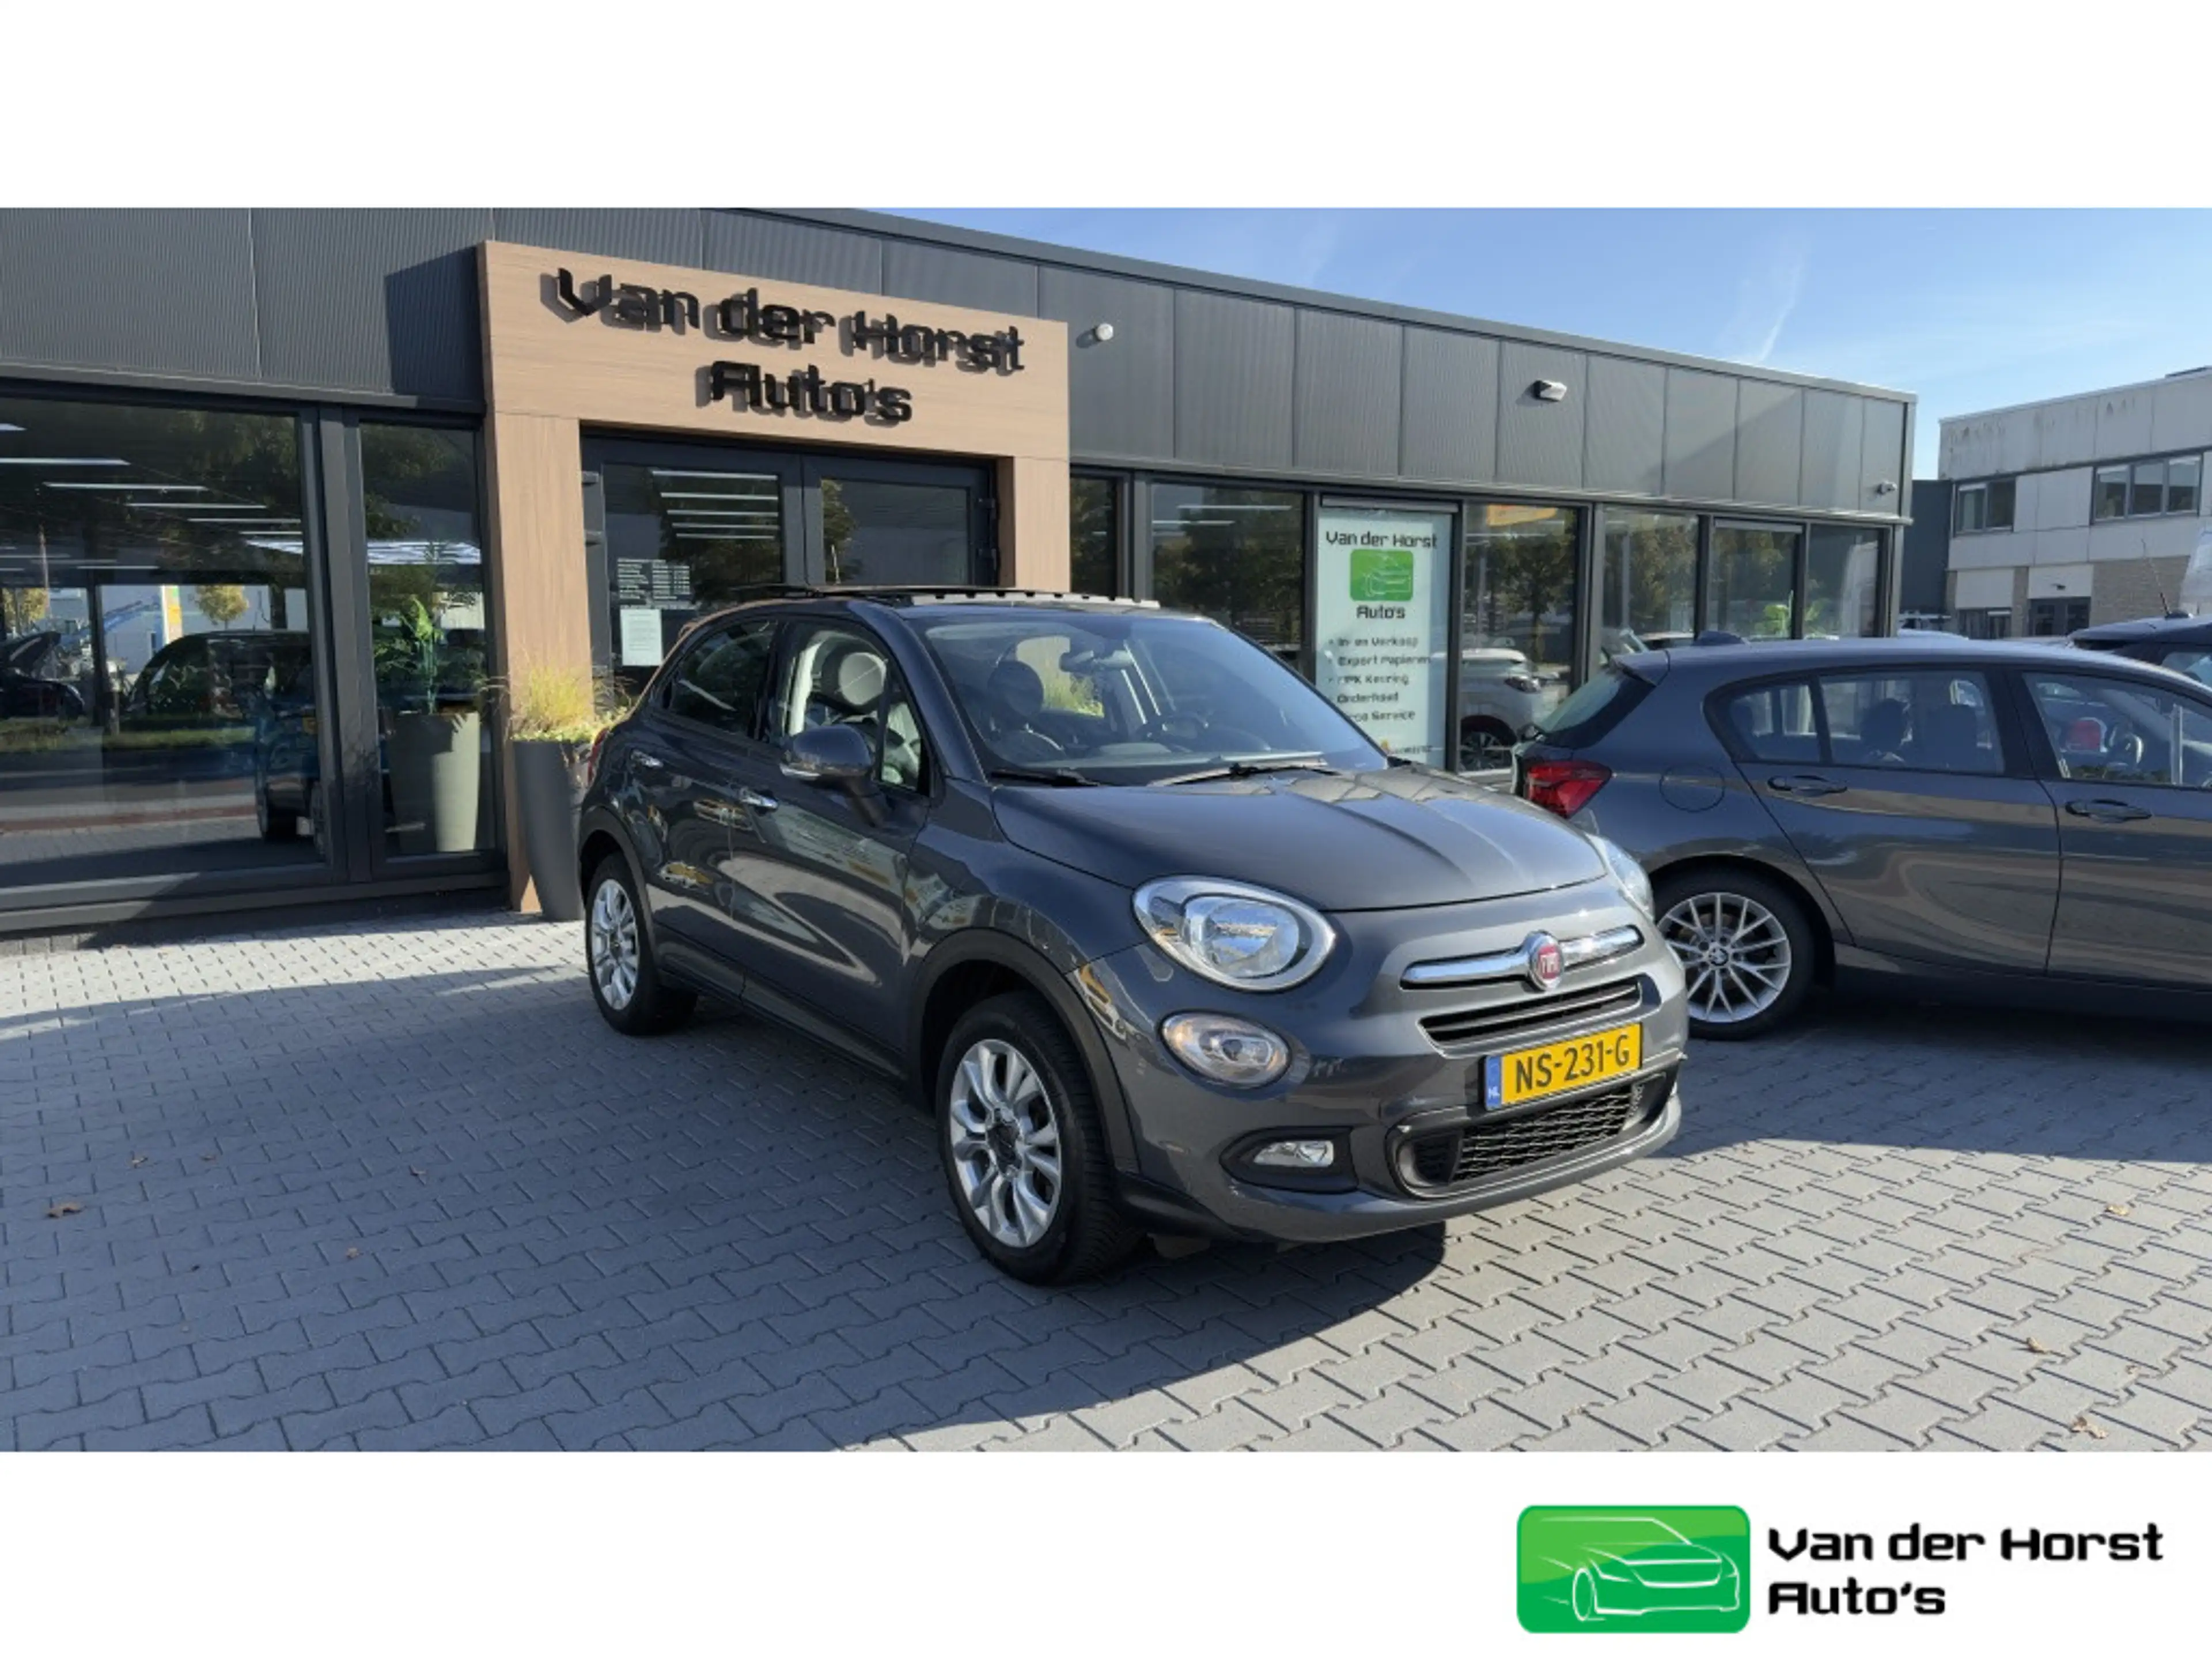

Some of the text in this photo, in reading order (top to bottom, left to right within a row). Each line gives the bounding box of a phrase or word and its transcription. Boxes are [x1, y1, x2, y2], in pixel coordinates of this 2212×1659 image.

[556, 267, 1024, 371] Van der Horst
[711, 359, 912, 422] Auto's
[1326, 531, 1437, 548] Van der Horst
[1338, 655, 1377, 667] Export
[1516, 1034, 1630, 1094] NS-231-G
